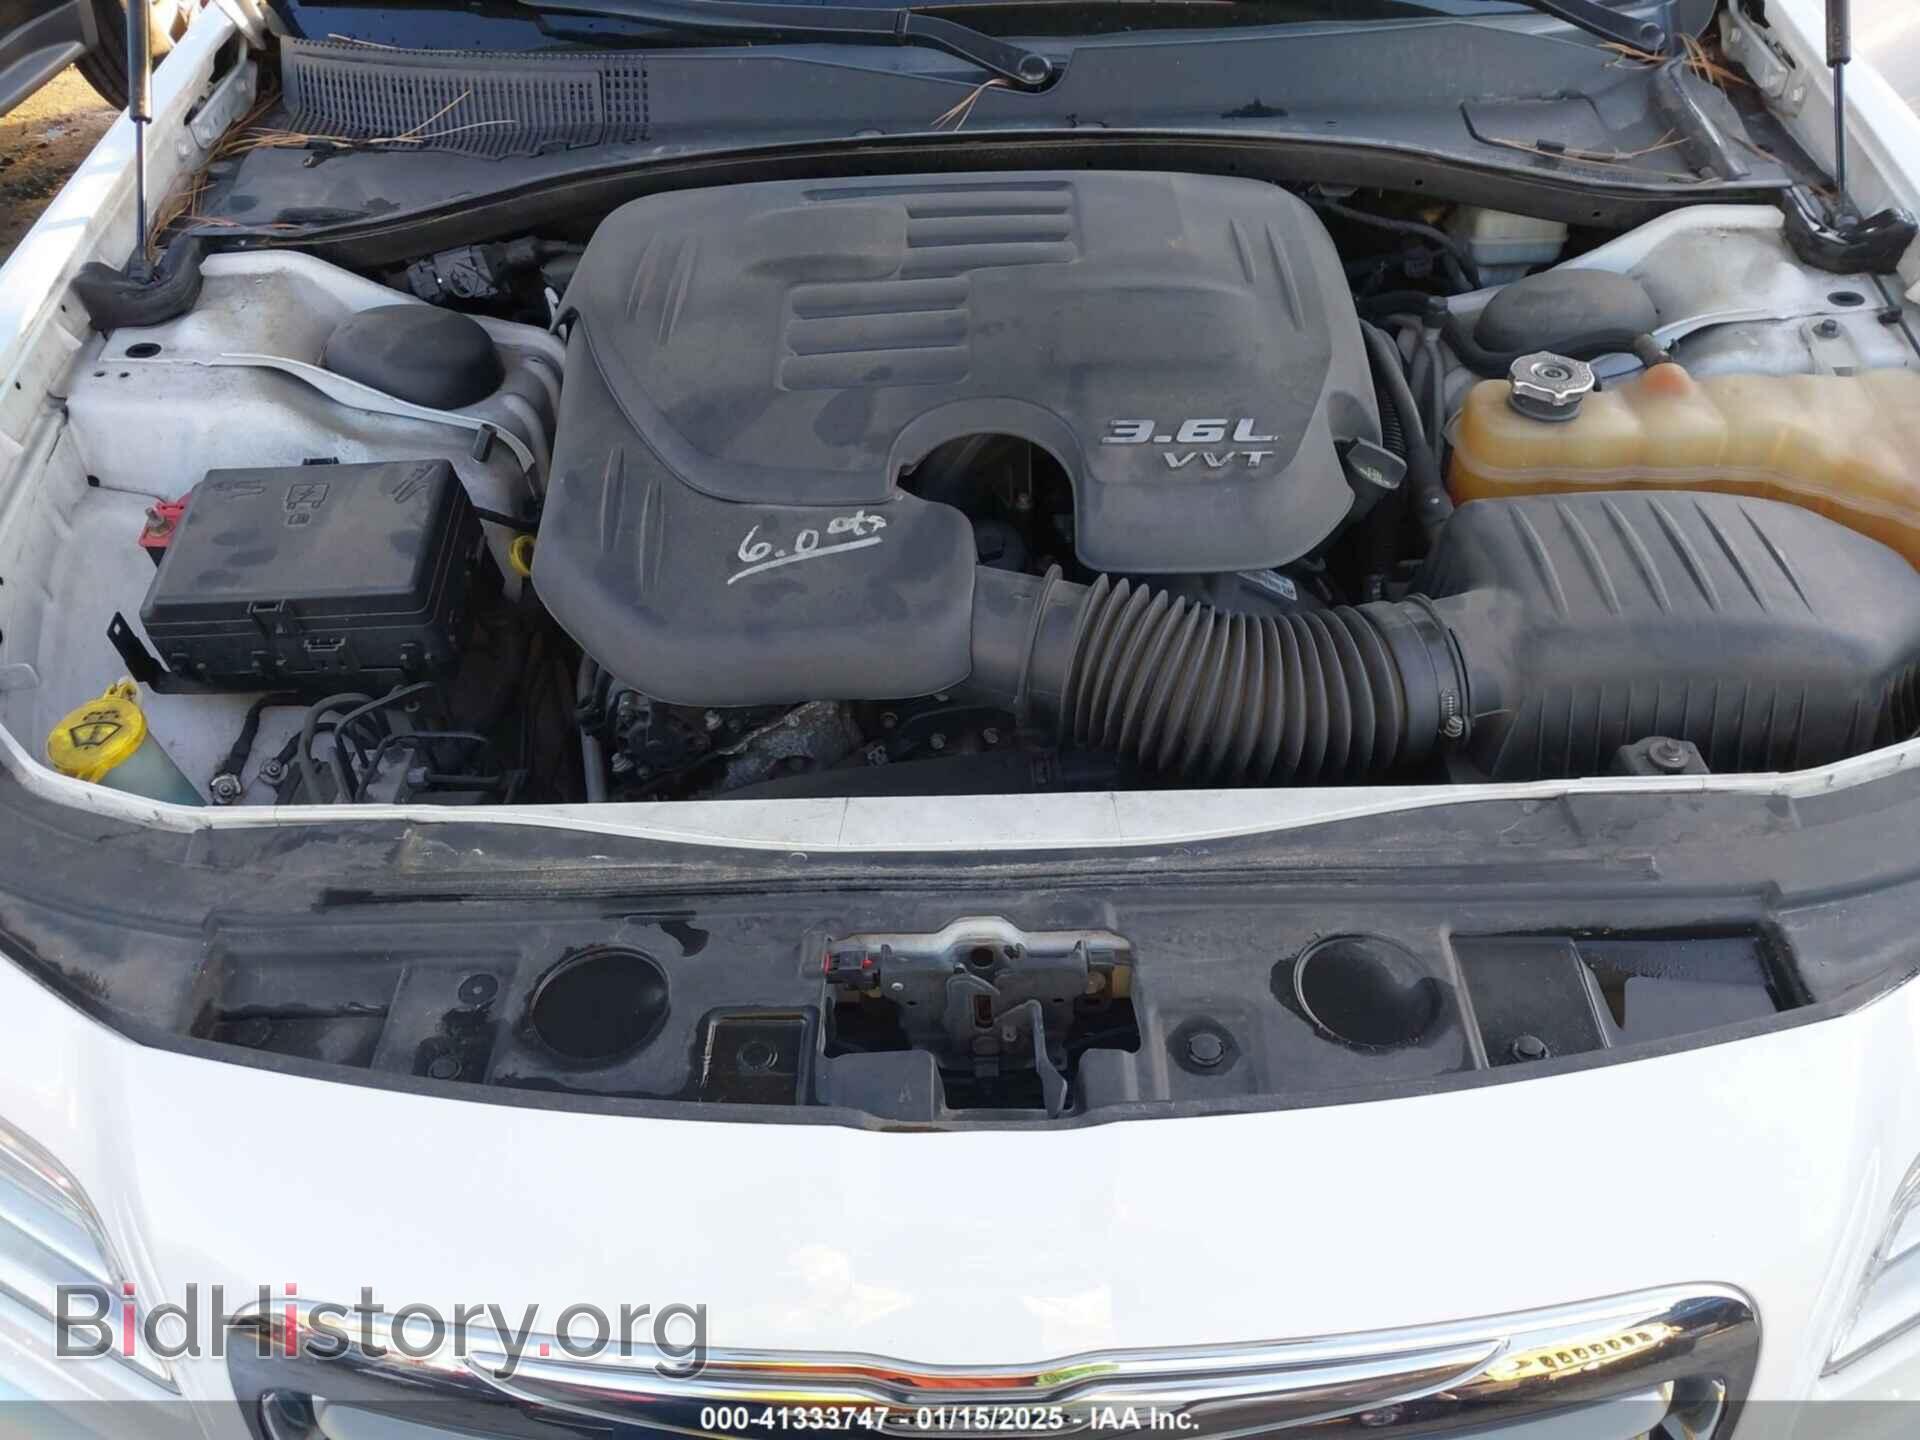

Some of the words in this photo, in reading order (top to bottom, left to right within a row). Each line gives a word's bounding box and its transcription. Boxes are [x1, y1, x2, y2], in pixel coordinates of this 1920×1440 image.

[1102, 418, 1279, 443] 3.6L
[1163, 451, 1273, 468] VVT
[738, 525, 819, 562] 6.0
